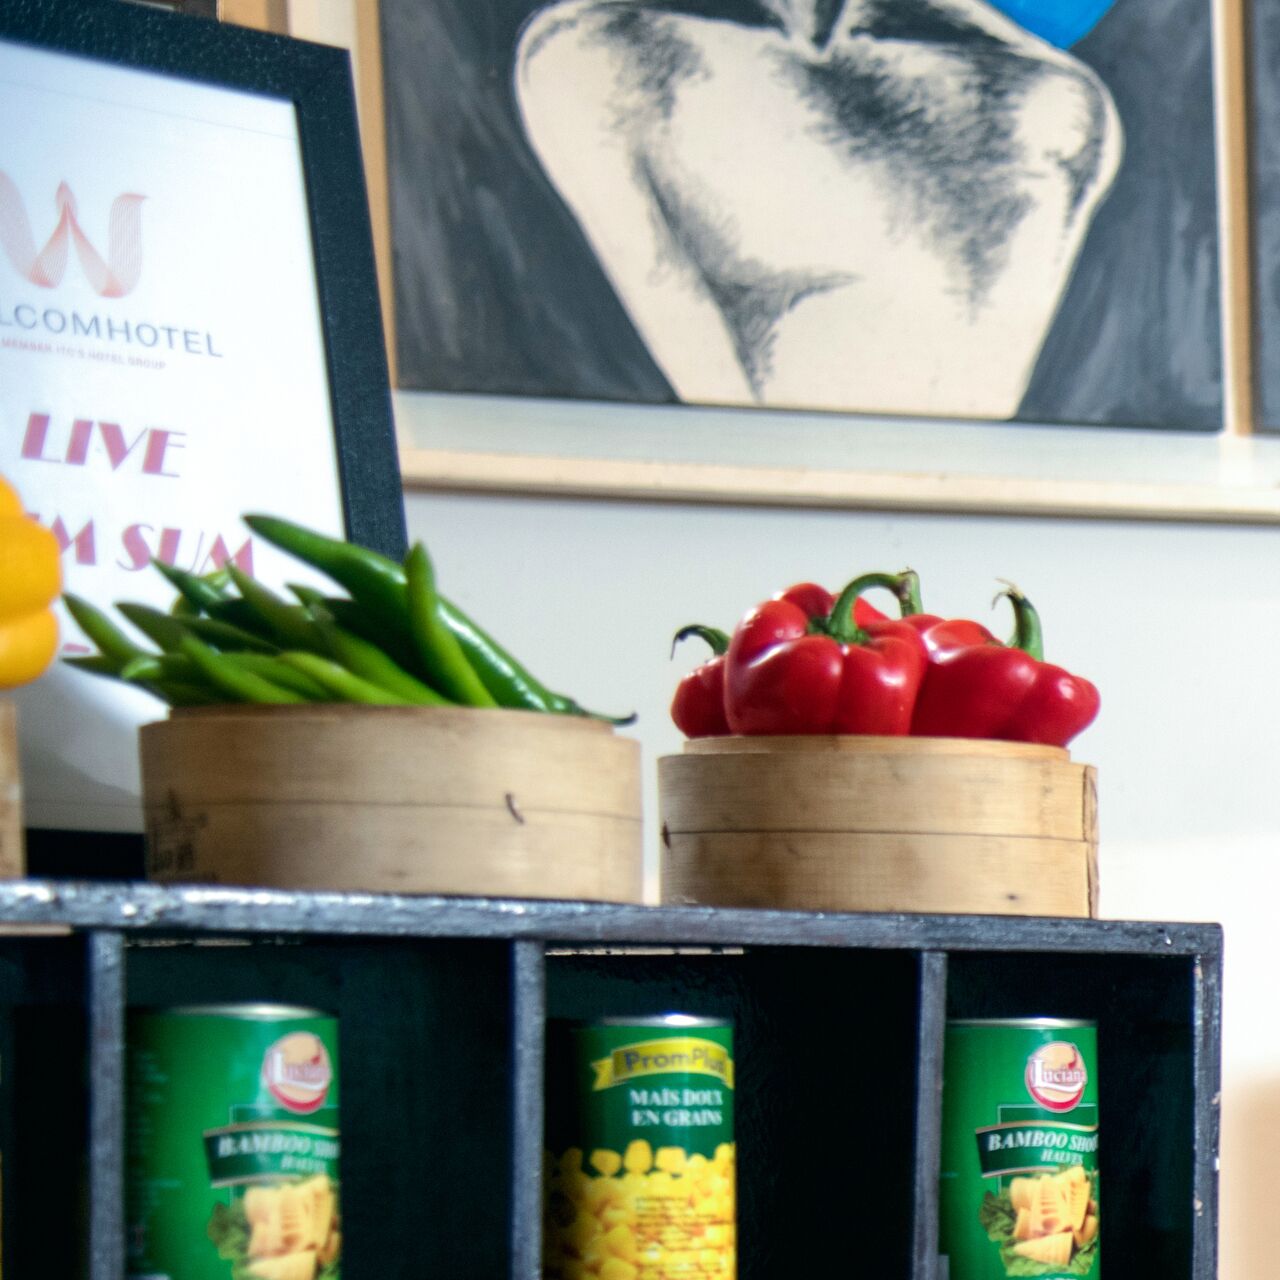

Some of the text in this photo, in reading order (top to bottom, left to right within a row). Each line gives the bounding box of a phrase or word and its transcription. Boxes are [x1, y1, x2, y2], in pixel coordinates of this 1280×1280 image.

[20, 412, 187, 478] LIVE
[116, 523, 254, 577] SUM
[632, 1109, 660, 1126] EN
[988, 1130, 1068, 1151] BAMBOO
